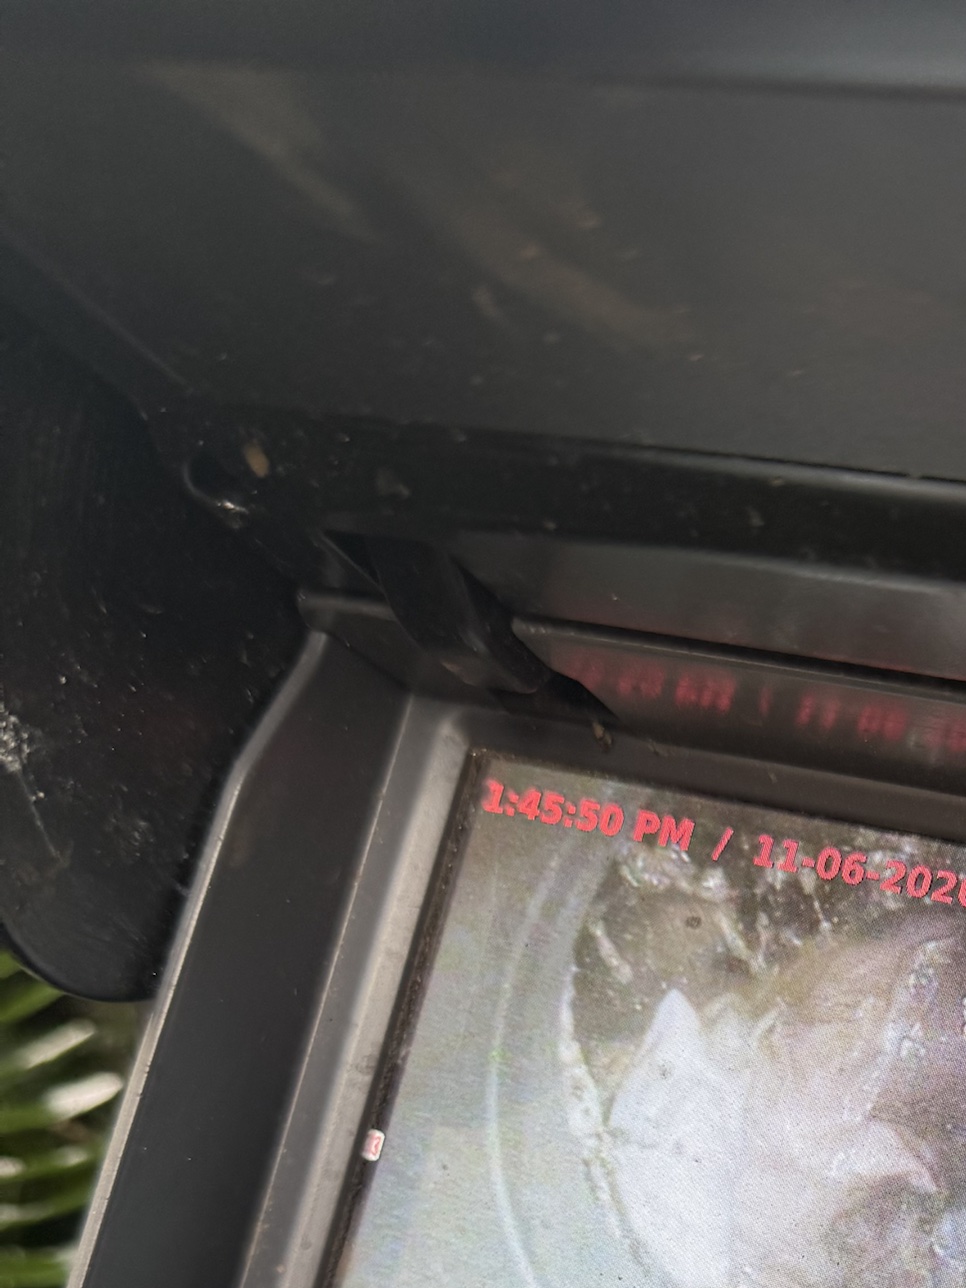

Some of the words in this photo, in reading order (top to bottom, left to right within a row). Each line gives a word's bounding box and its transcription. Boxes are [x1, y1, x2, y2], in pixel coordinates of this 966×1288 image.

[482, 778, 625, 837] 1:45:50
[632, 809, 696, 852] PM
[710, 826, 735, 862] /
